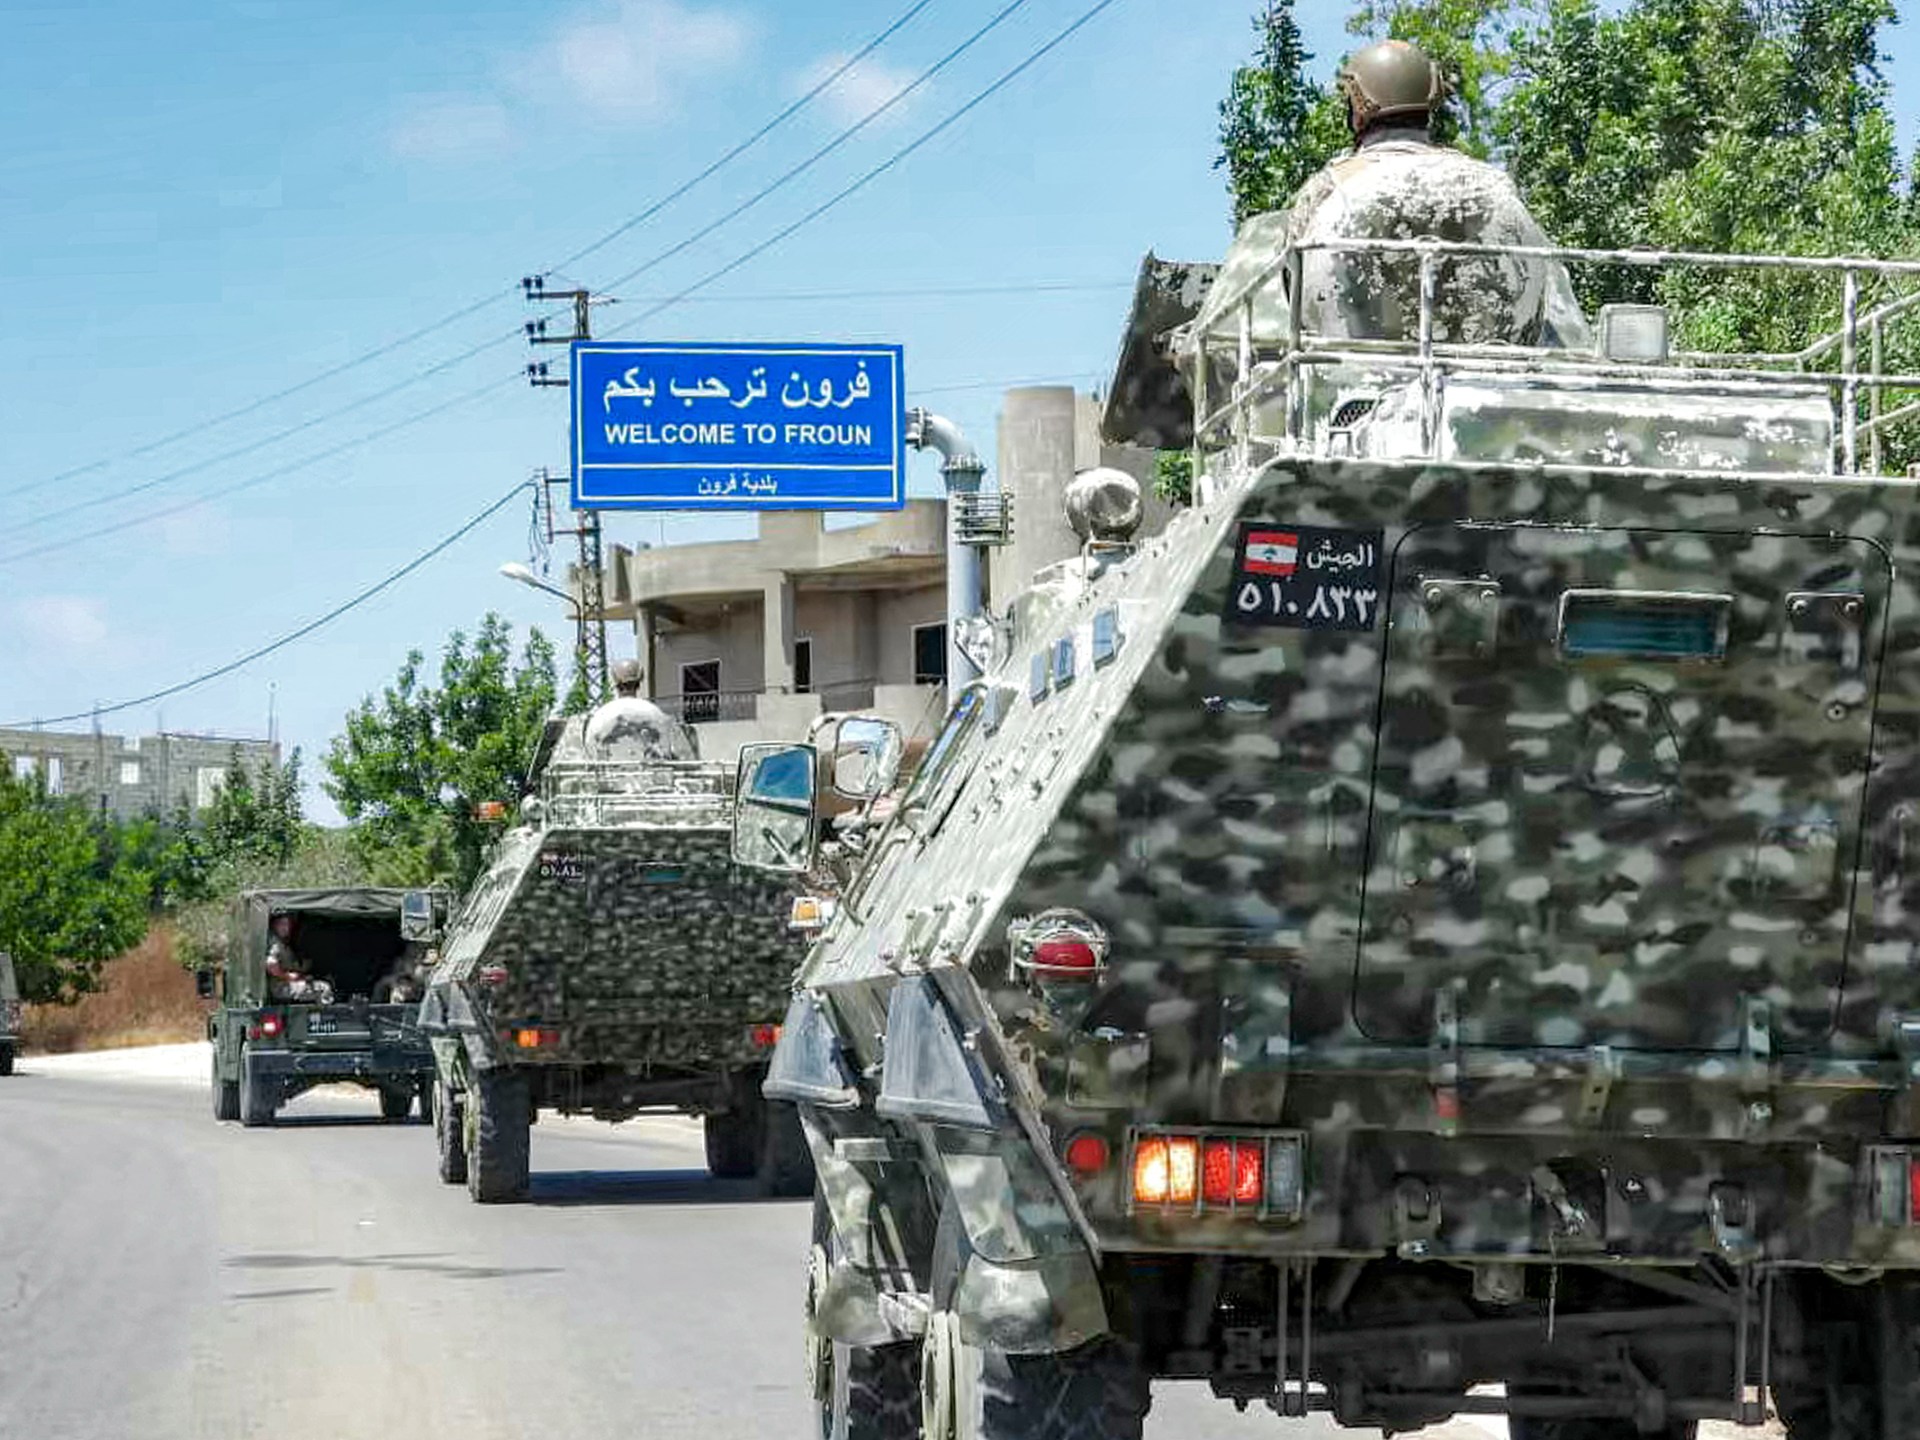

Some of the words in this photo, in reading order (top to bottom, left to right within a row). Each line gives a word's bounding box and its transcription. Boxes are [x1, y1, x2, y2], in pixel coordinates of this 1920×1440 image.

[603, 366, 656, 412] بكم
[669, 366, 767, 407] ترحب
[781, 360, 871, 408] فرون
[604, 423, 736, 445] WELCOME
[742, 423, 777, 444] TO
[783, 425, 871, 446] FROUN
[698, 473, 737, 495] فرون
[741, 472, 778, 495] بلدية
[1306, 538, 1373, 573] الجيش
[1237, 582, 1378, 623] ٥١٠٨٣٣
